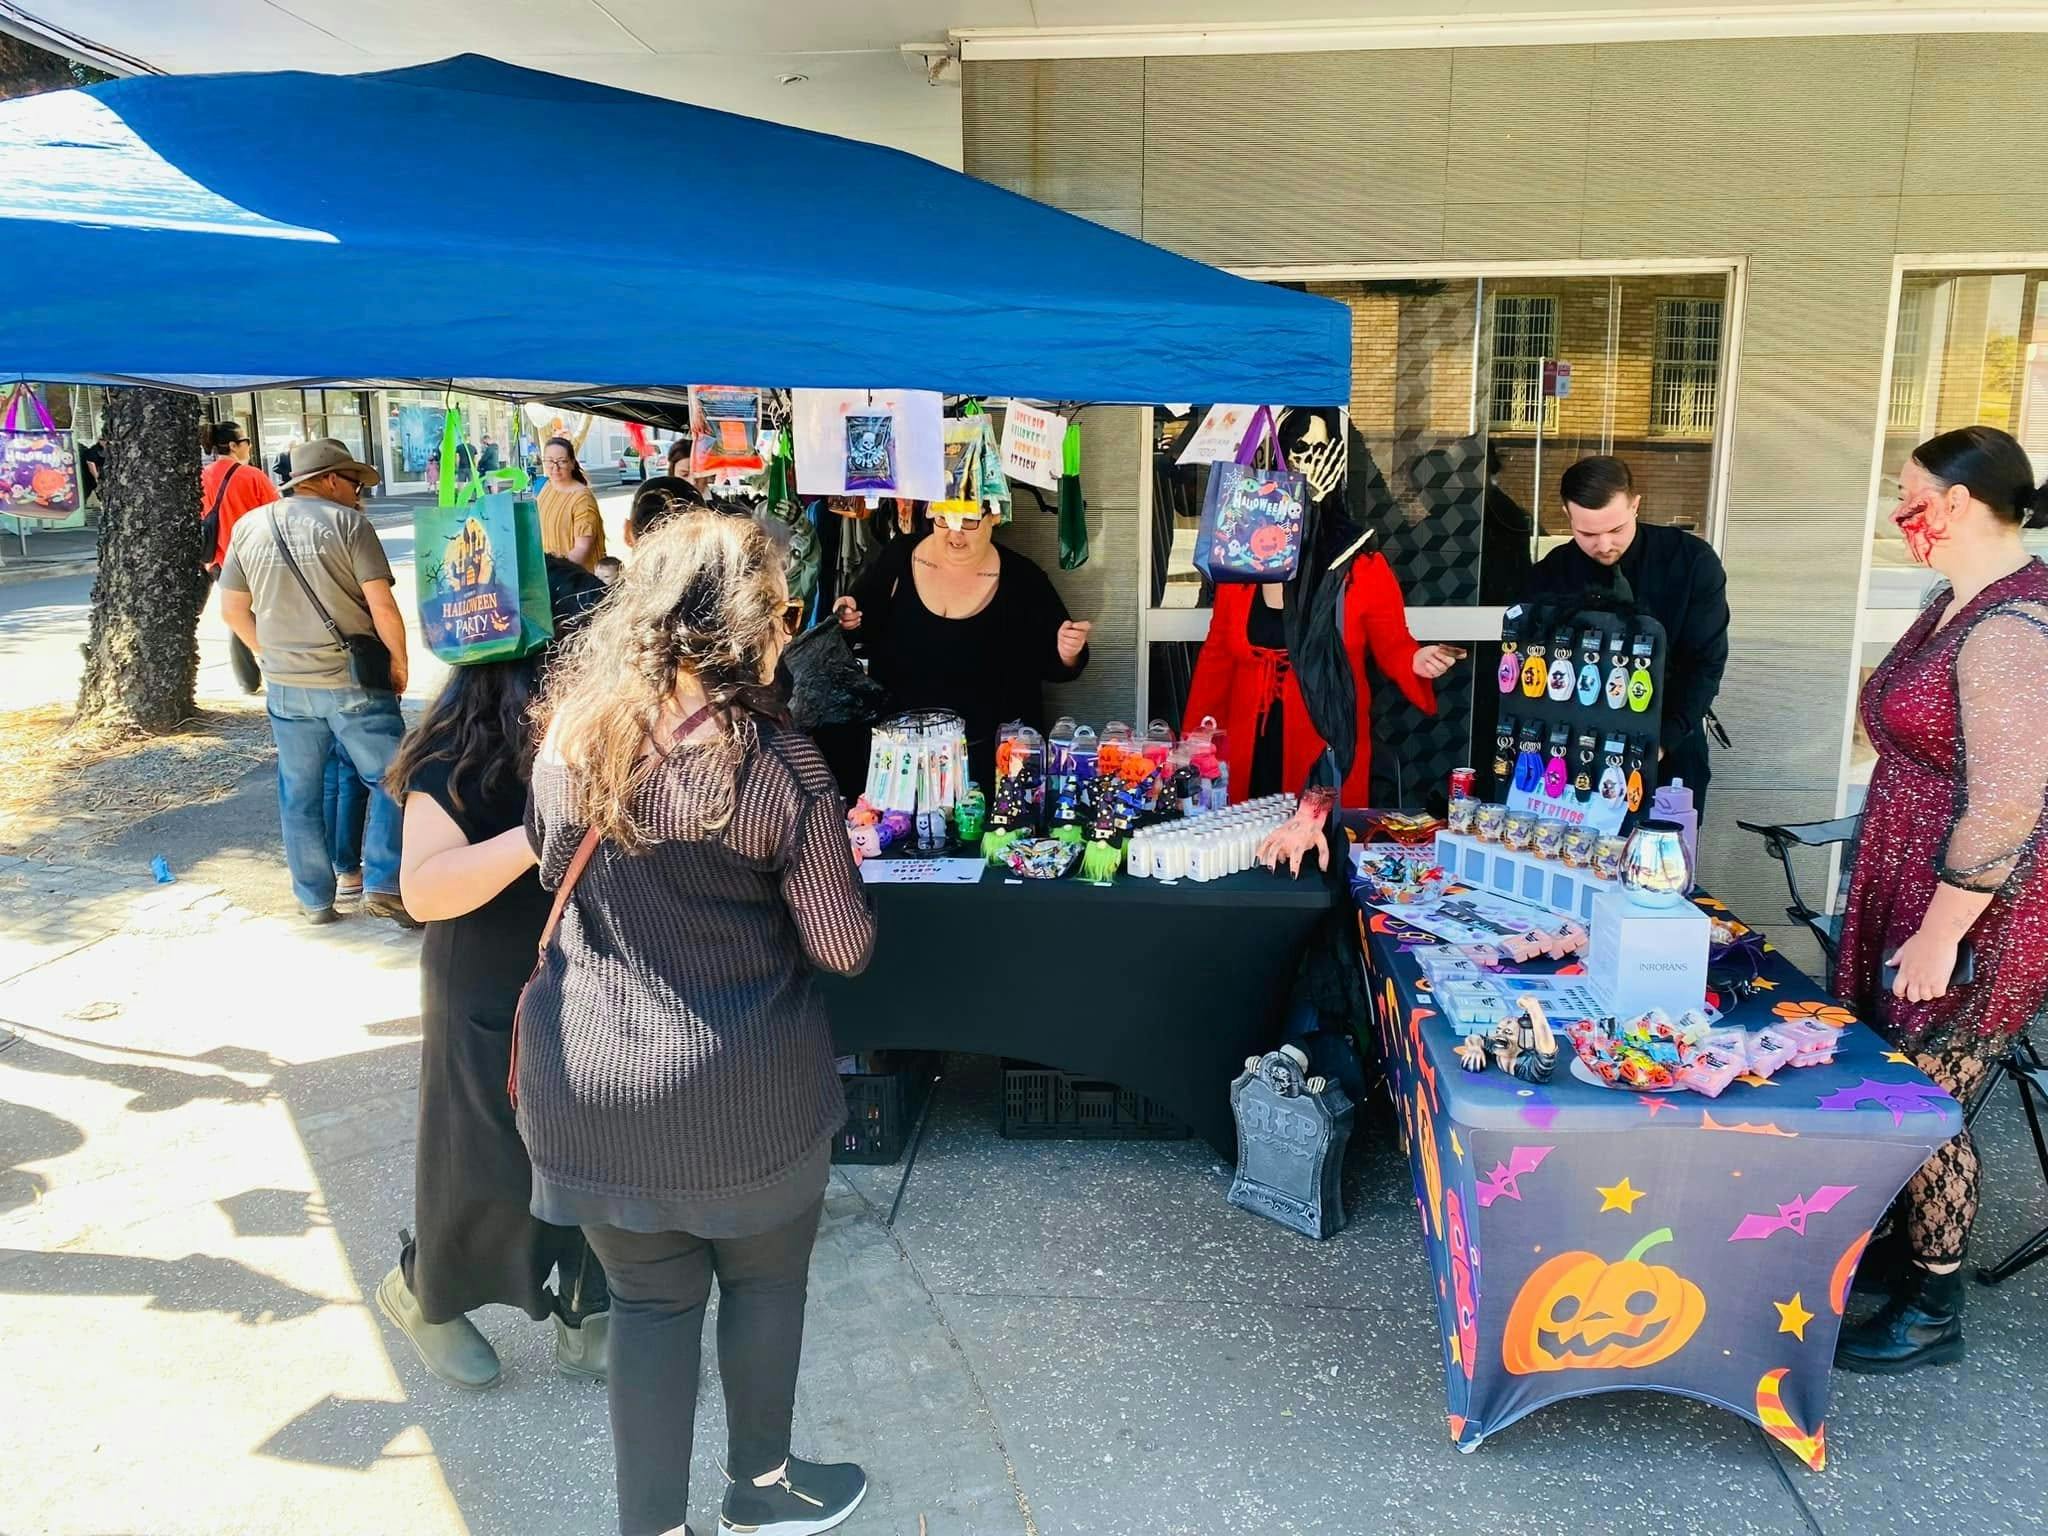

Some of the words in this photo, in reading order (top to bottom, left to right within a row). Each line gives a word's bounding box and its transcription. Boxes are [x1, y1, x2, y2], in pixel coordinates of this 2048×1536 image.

[1232, 488, 1289, 522] HALLOWEEN
[442, 592, 497, 618] HALLOWEEN
[455, 614, 488, 639] PARTY
[1247, 1097, 1317, 1145] RIP
